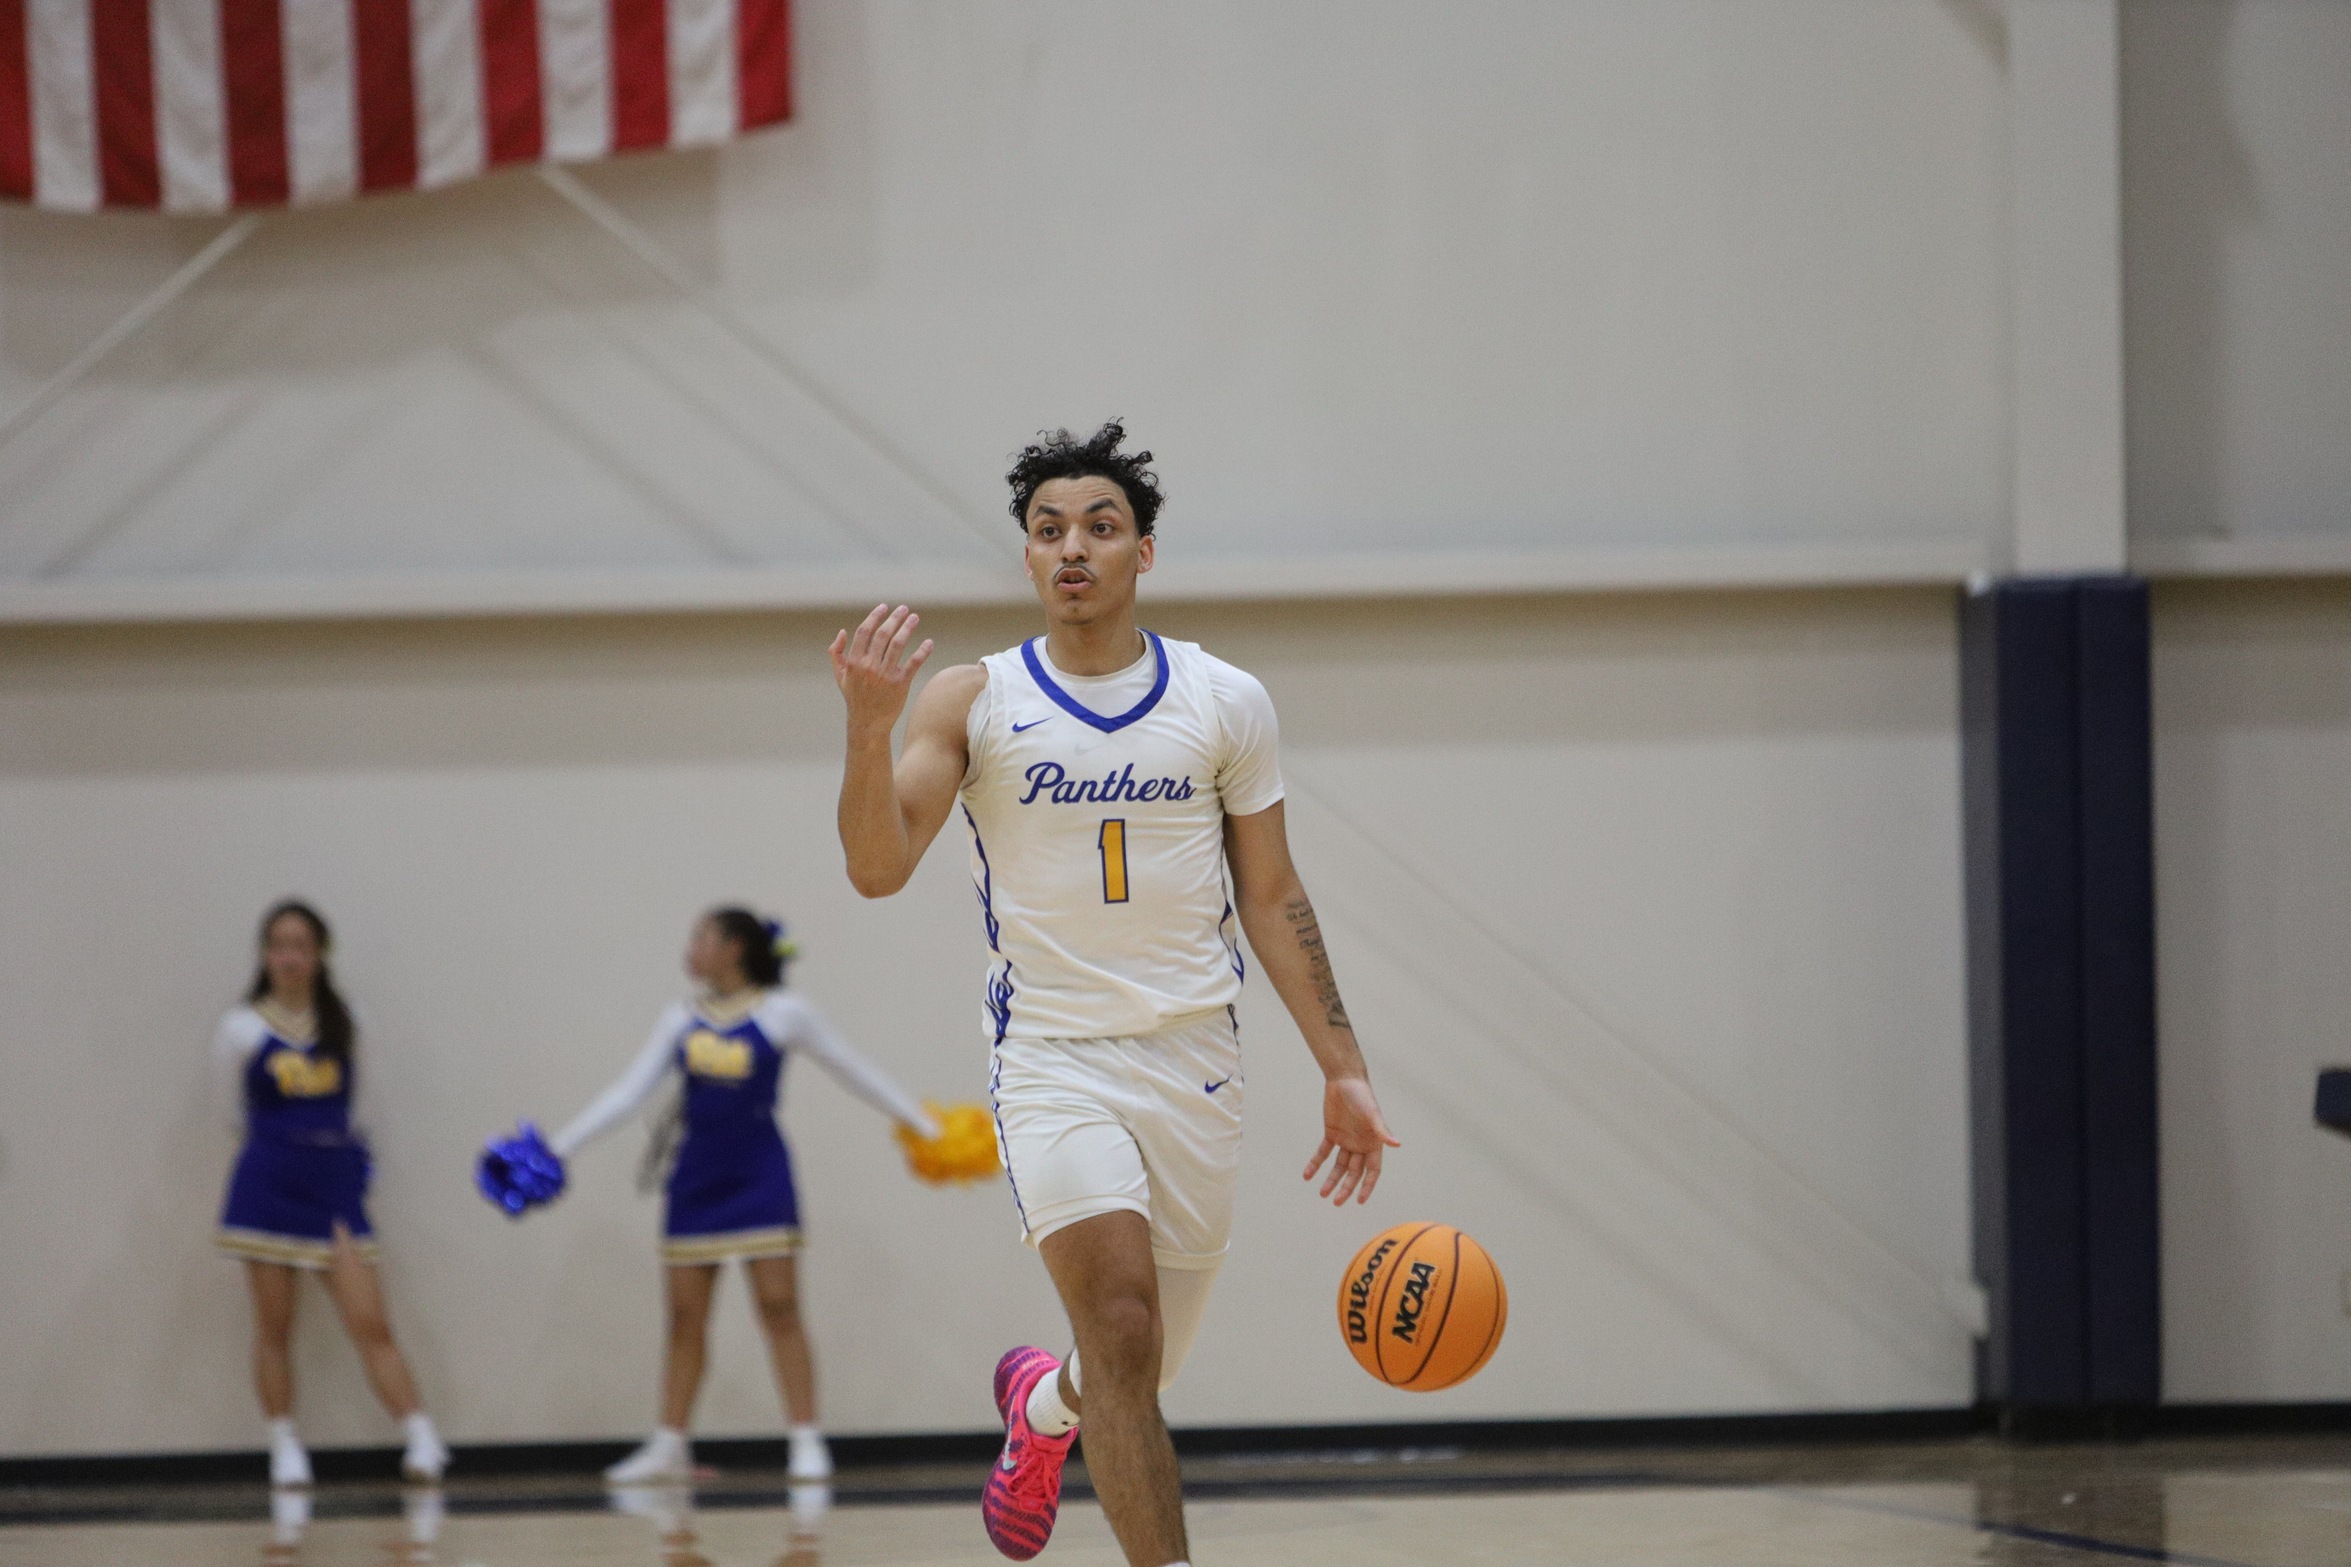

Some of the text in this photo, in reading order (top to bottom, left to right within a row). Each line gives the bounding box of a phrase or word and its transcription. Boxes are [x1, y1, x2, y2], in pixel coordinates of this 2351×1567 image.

[1019, 762, 1197, 804] Panthers
[1098, 818, 1129, 903] 1
[1348, 1239, 1398, 1344] Wilson
[1392, 1262, 1436, 1343] NCAA
